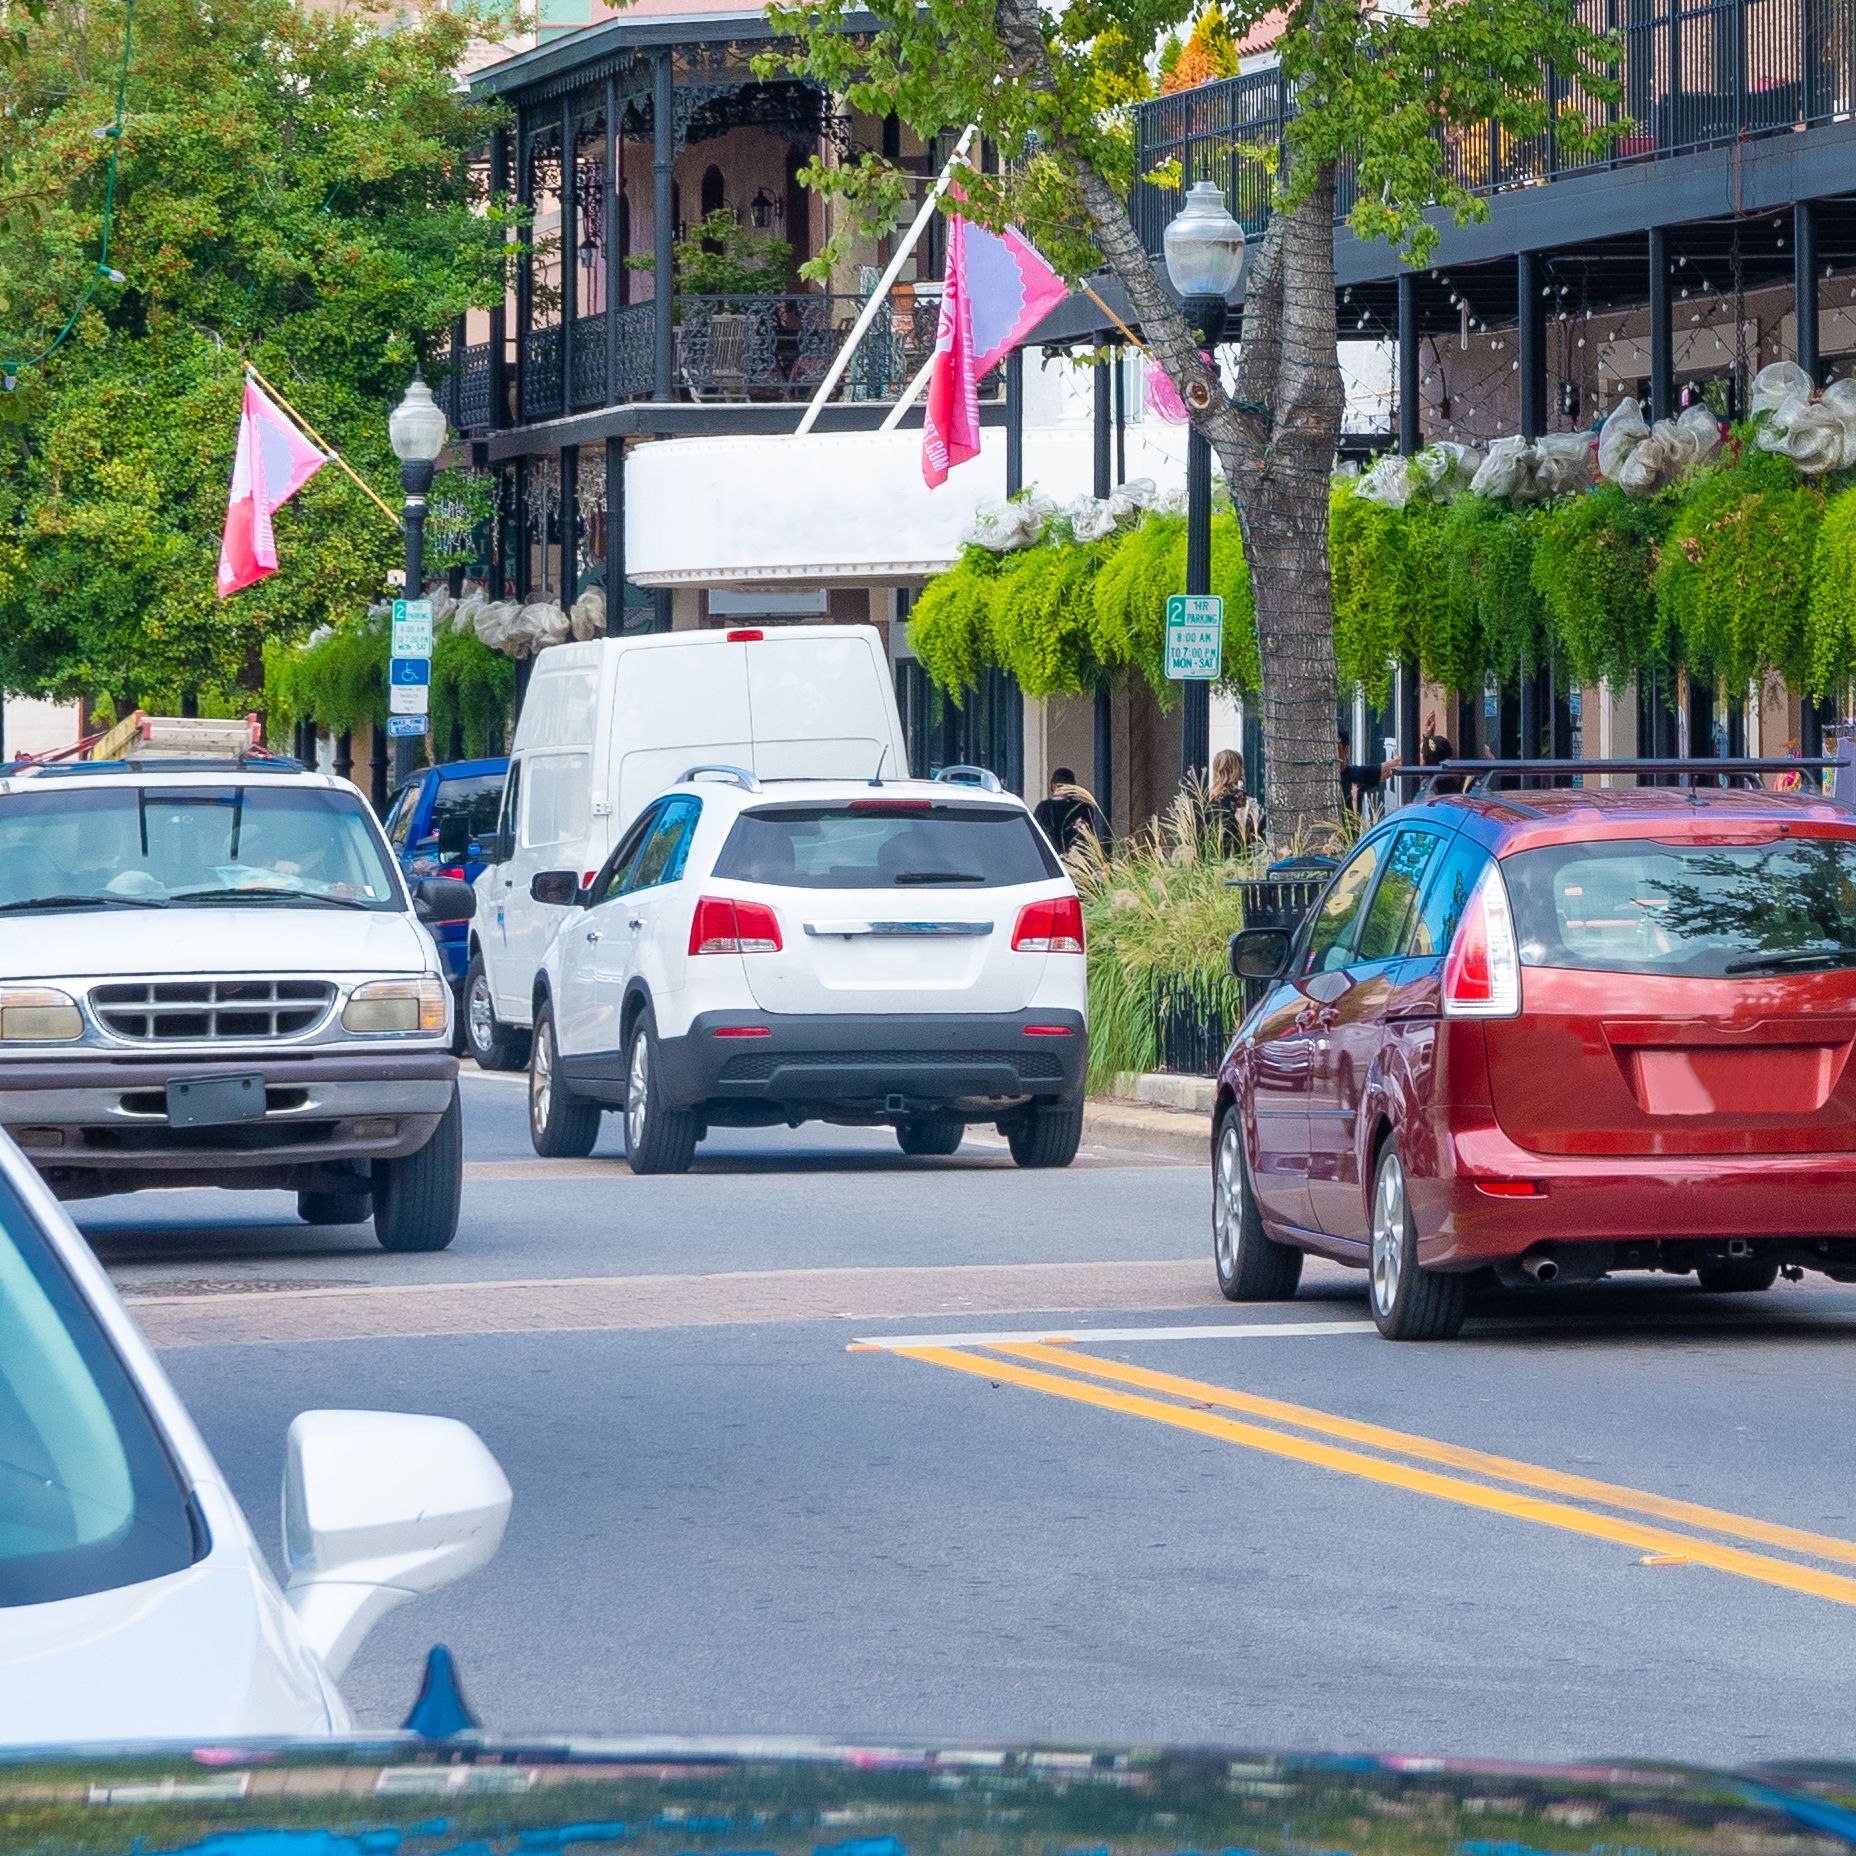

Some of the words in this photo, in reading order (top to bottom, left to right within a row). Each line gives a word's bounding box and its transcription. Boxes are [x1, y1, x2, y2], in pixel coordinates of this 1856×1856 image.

[396, 605, 405, 619] 2
[1171, 602, 1182, 622] 2
[1186, 614, 1217, 624] PARKING
[1199, 632, 1212, 642] AM
[1170, 647, 1181, 658] TO
[1183, 646, 1203, 658] 7:00
[1172, 658, 1193, 669] MON
[1198, 658, 1214, 669] SAT
